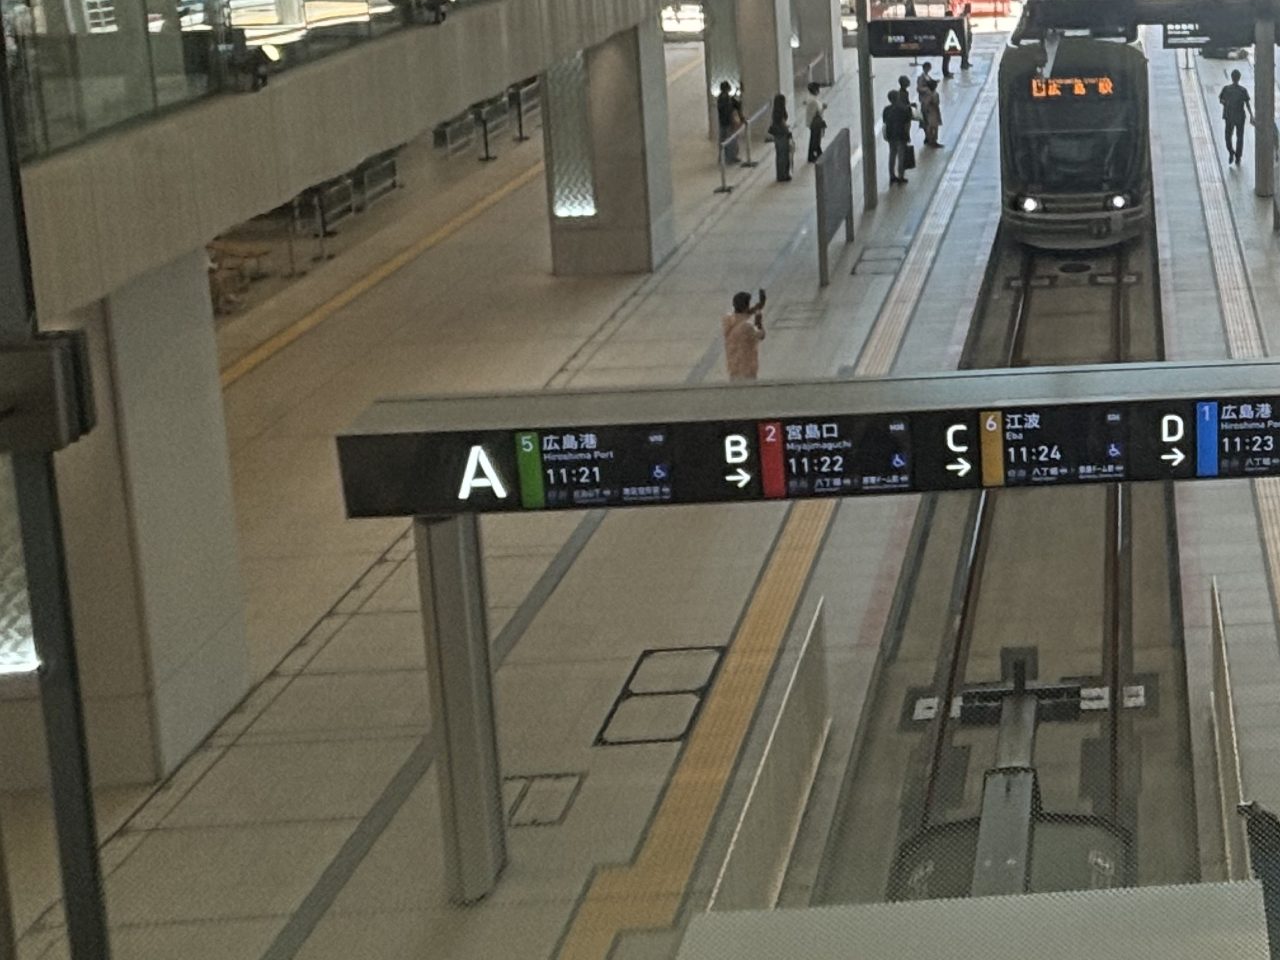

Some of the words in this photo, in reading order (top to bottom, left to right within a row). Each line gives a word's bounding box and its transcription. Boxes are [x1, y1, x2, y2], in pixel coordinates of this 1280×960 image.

[944, 28, 962, 51] A
[1202, 404, 1211, 421] 1
[1220, 403, 1273, 420] 広島港
[985, 414, 998, 431] 6
[1005, 413, 1041, 430] 江波
[1160, 414, 1185, 443] D
[764, 425, 777, 442] 2
[786, 423, 839, 440] 宮島口
[946, 424, 969, 453] C
[521, 434, 534, 452] 5
[542, 433, 598, 451] 広島港
[724, 435, 749, 464] B
[1222, 435, 1274, 453] 11:23
[1007, 444, 1062, 463] 11:24
[458, 445, 507, 500] A
[788, 455, 844, 474] 11:22
[546, 466, 600, 485] 11:21
